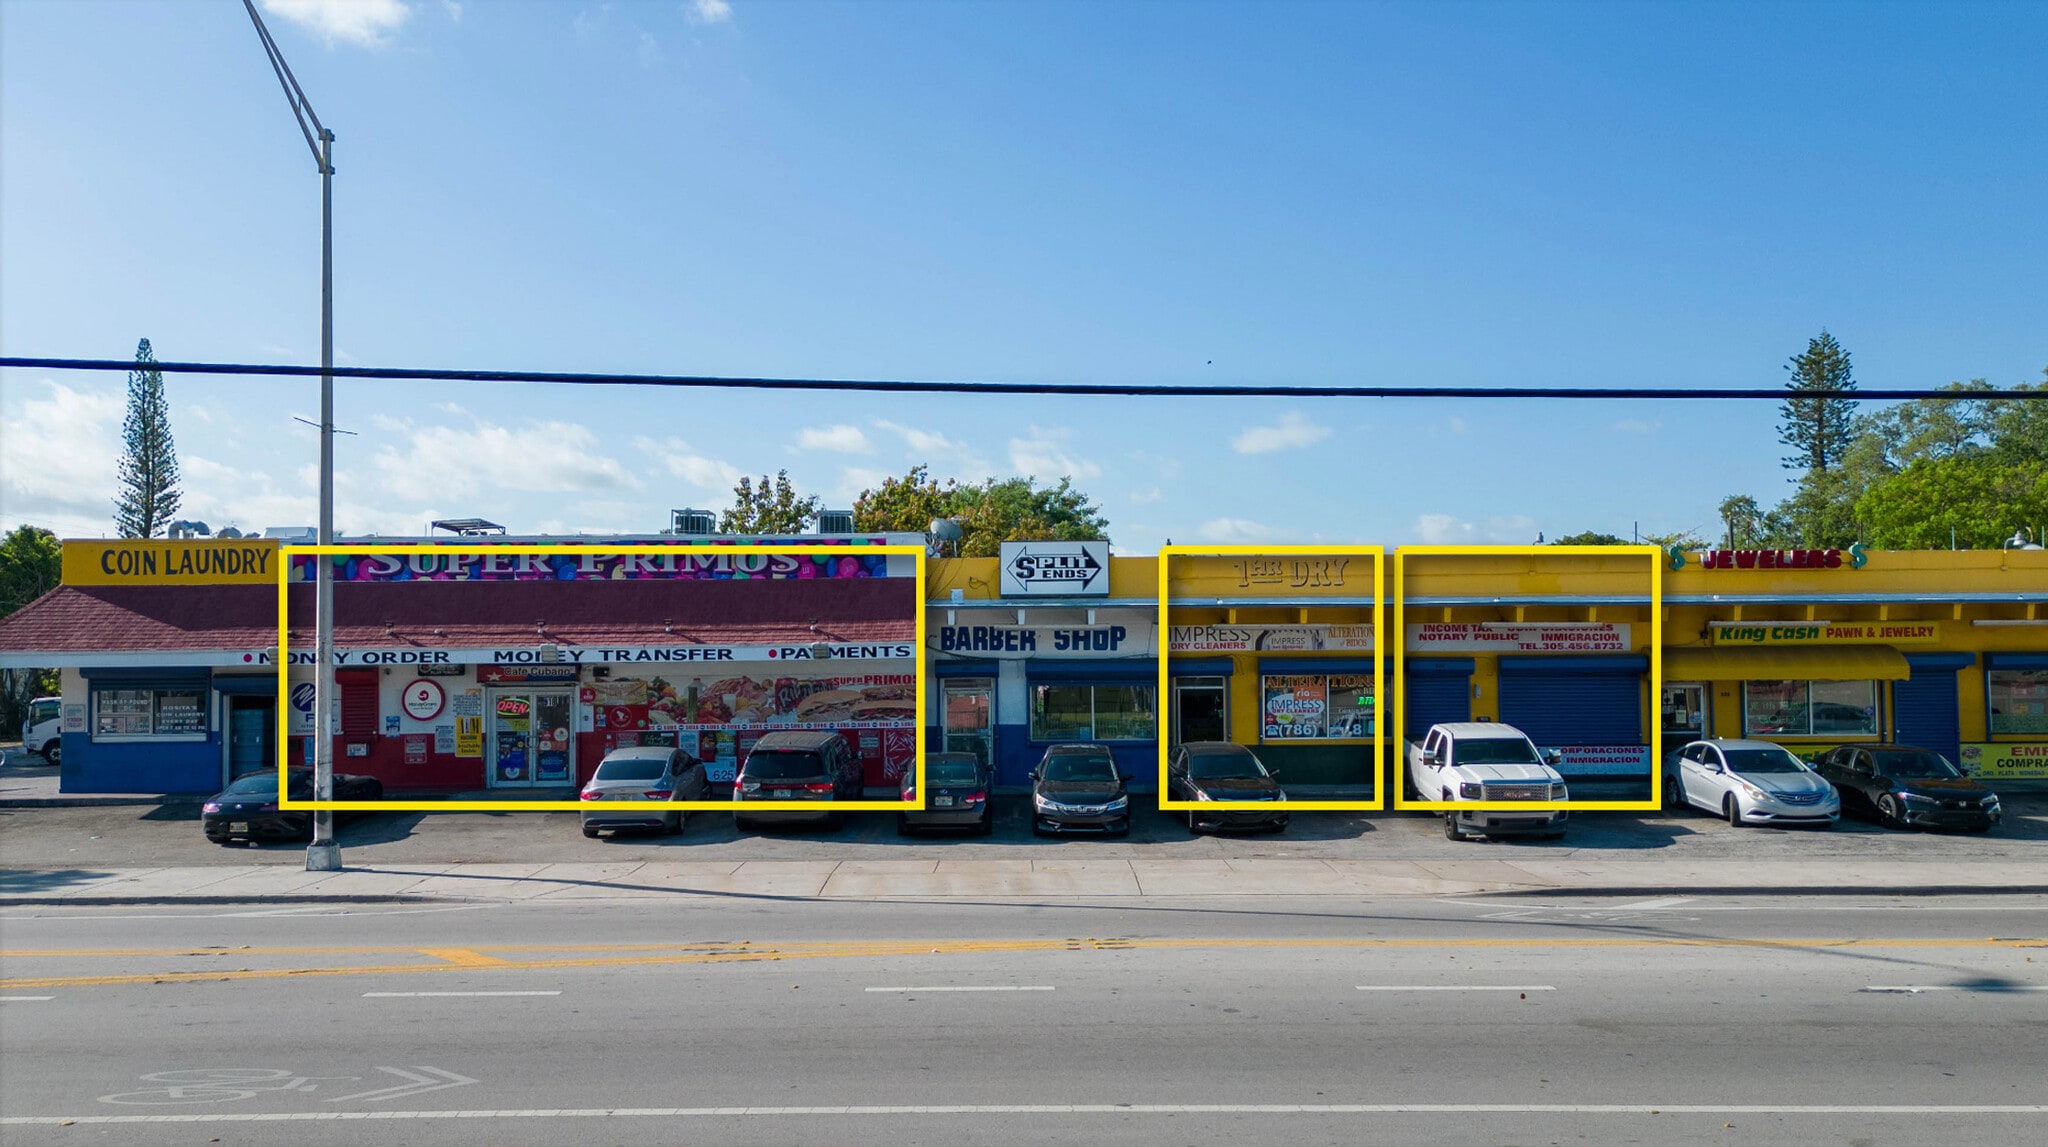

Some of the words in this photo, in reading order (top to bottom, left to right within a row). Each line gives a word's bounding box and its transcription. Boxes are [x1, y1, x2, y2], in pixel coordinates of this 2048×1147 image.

[101, 549, 157, 576] COIN
[165, 548, 272, 576] LAUNDRY
[368, 553, 553, 574] SUPER
[576, 553, 799, 573] PRIMOS
[1700, 549, 1842, 570] JEWELERS
[1015, 555, 1089, 579] SPLIT
[1042, 568, 1087, 579] ENDS
[1290, 559, 1350, 588] DRY
[1168, 627, 1251, 642] IMPRESS
[1423, 624, 1468, 633] INCOME
[1471, 624, 1493, 632] TAX
[1720, 626, 1766, 642] King
[1771, 626, 1819, 640] Cash
[1826, 626, 1863, 639] PAWN
[1867, 627, 1875, 638] &
[1878, 626, 1935, 638] JEWELRY
[940, 626, 1036, 651] BARBER
[1054, 626, 1126, 651] SHOP
[1271, 637, 1306, 645] IMPRESS
[1418, 633, 1467, 641] NOTARY
[1473, 633, 1519, 641] PUBLIC
[1541, 633, 1620, 641] INMIGRACION
[598, 648, 734, 661] TRANSFER
[781, 645, 911, 660] PAMENTS
[1171, 642, 1191, 650] DRY
[1193, 642, 1247, 650] CLEANERS
[259, 651, 349, 664] MONY
[362, 651, 450, 664] ORDER
[504, 667, 528, 676] Cafe
[530, 667, 571, 676] Cubano
[833, 677, 863, 687] SUPER
[497, 700, 528, 714] OPEN
[1271, 699, 1321, 710] IMPRESS
[1279, 724, 1317, 738] (786)
[1566, 756, 1640, 764] INMIGRACION
